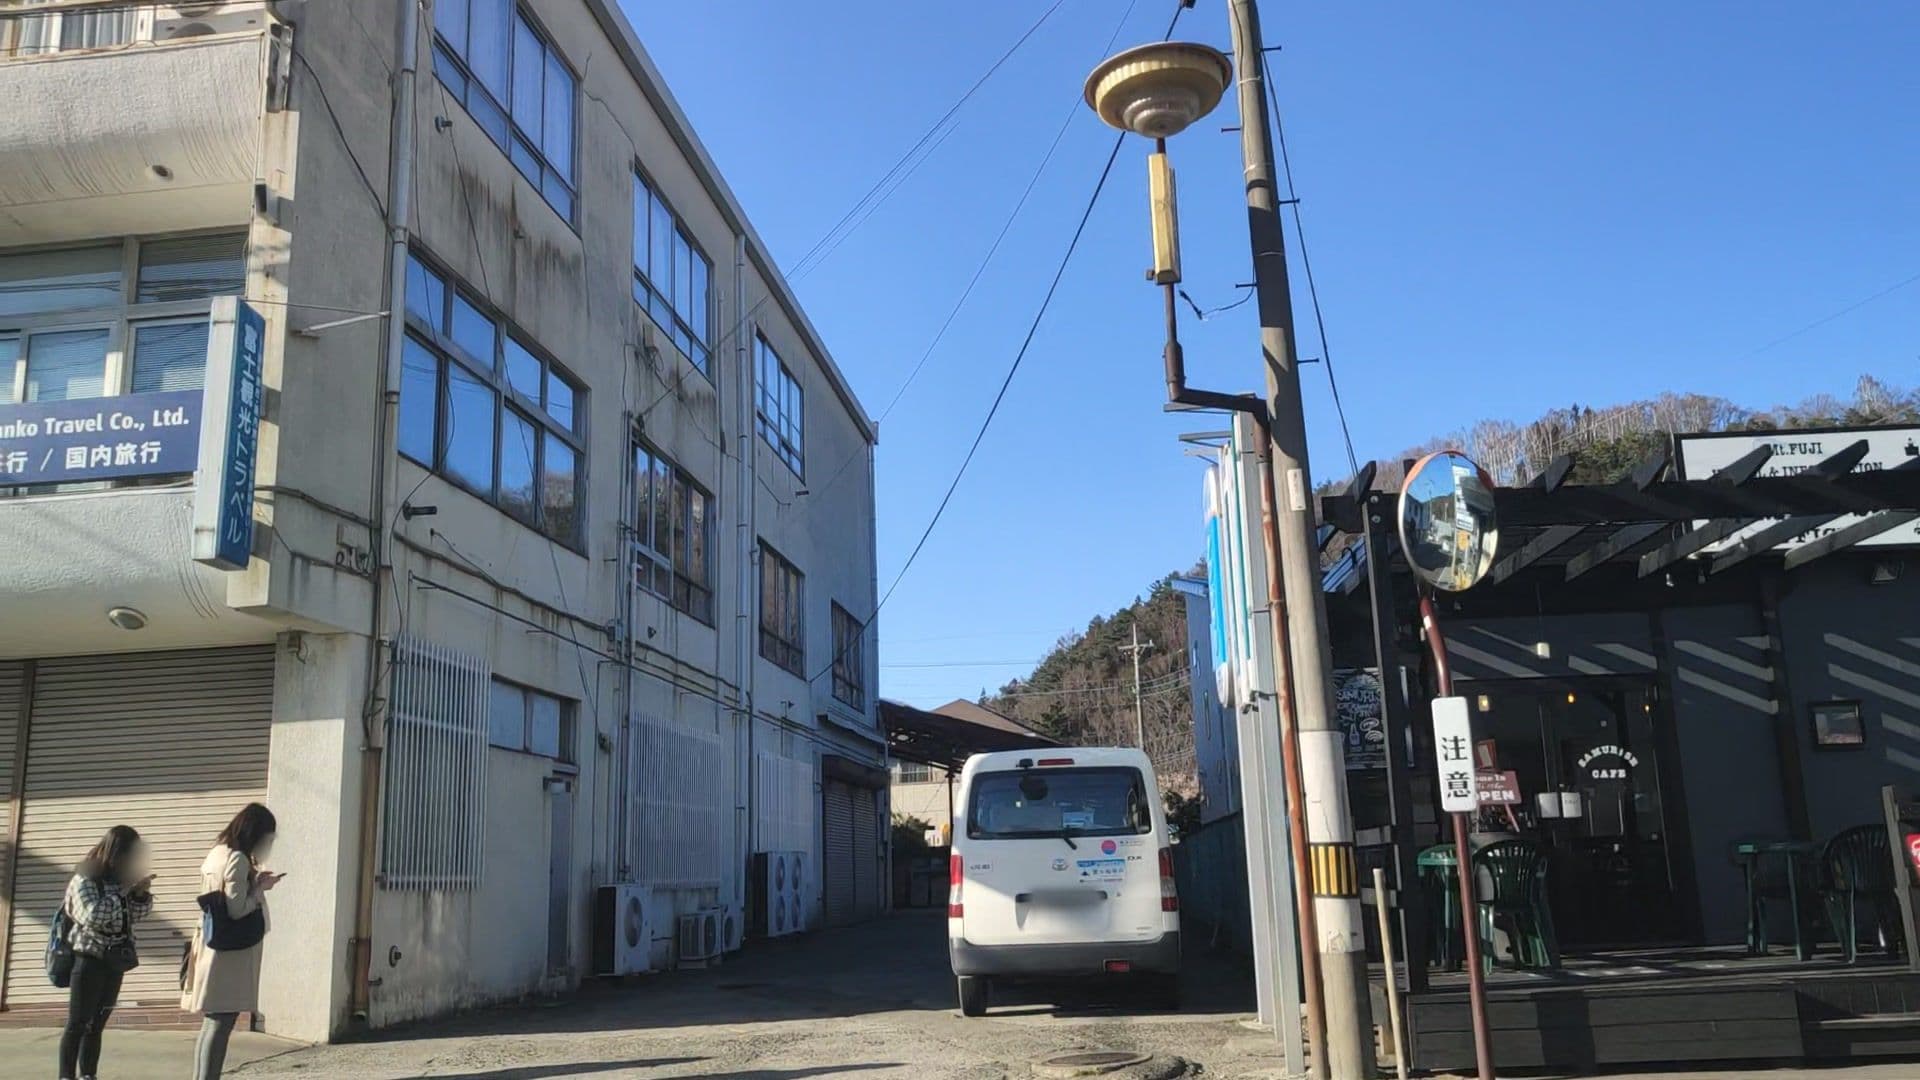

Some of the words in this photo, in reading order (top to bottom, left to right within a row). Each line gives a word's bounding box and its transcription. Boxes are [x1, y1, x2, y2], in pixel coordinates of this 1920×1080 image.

[45, 414, 103, 435] Travel
[110, 412, 145, 431] Co.,
[153, 407, 190, 426] Ltd.
[0, 450, 28, 475] 行
[65, 441, 162, 470] 国内旅行
[1441, 736, 1471, 798] 注意
[1592, 769, 1626, 779] CAFE
